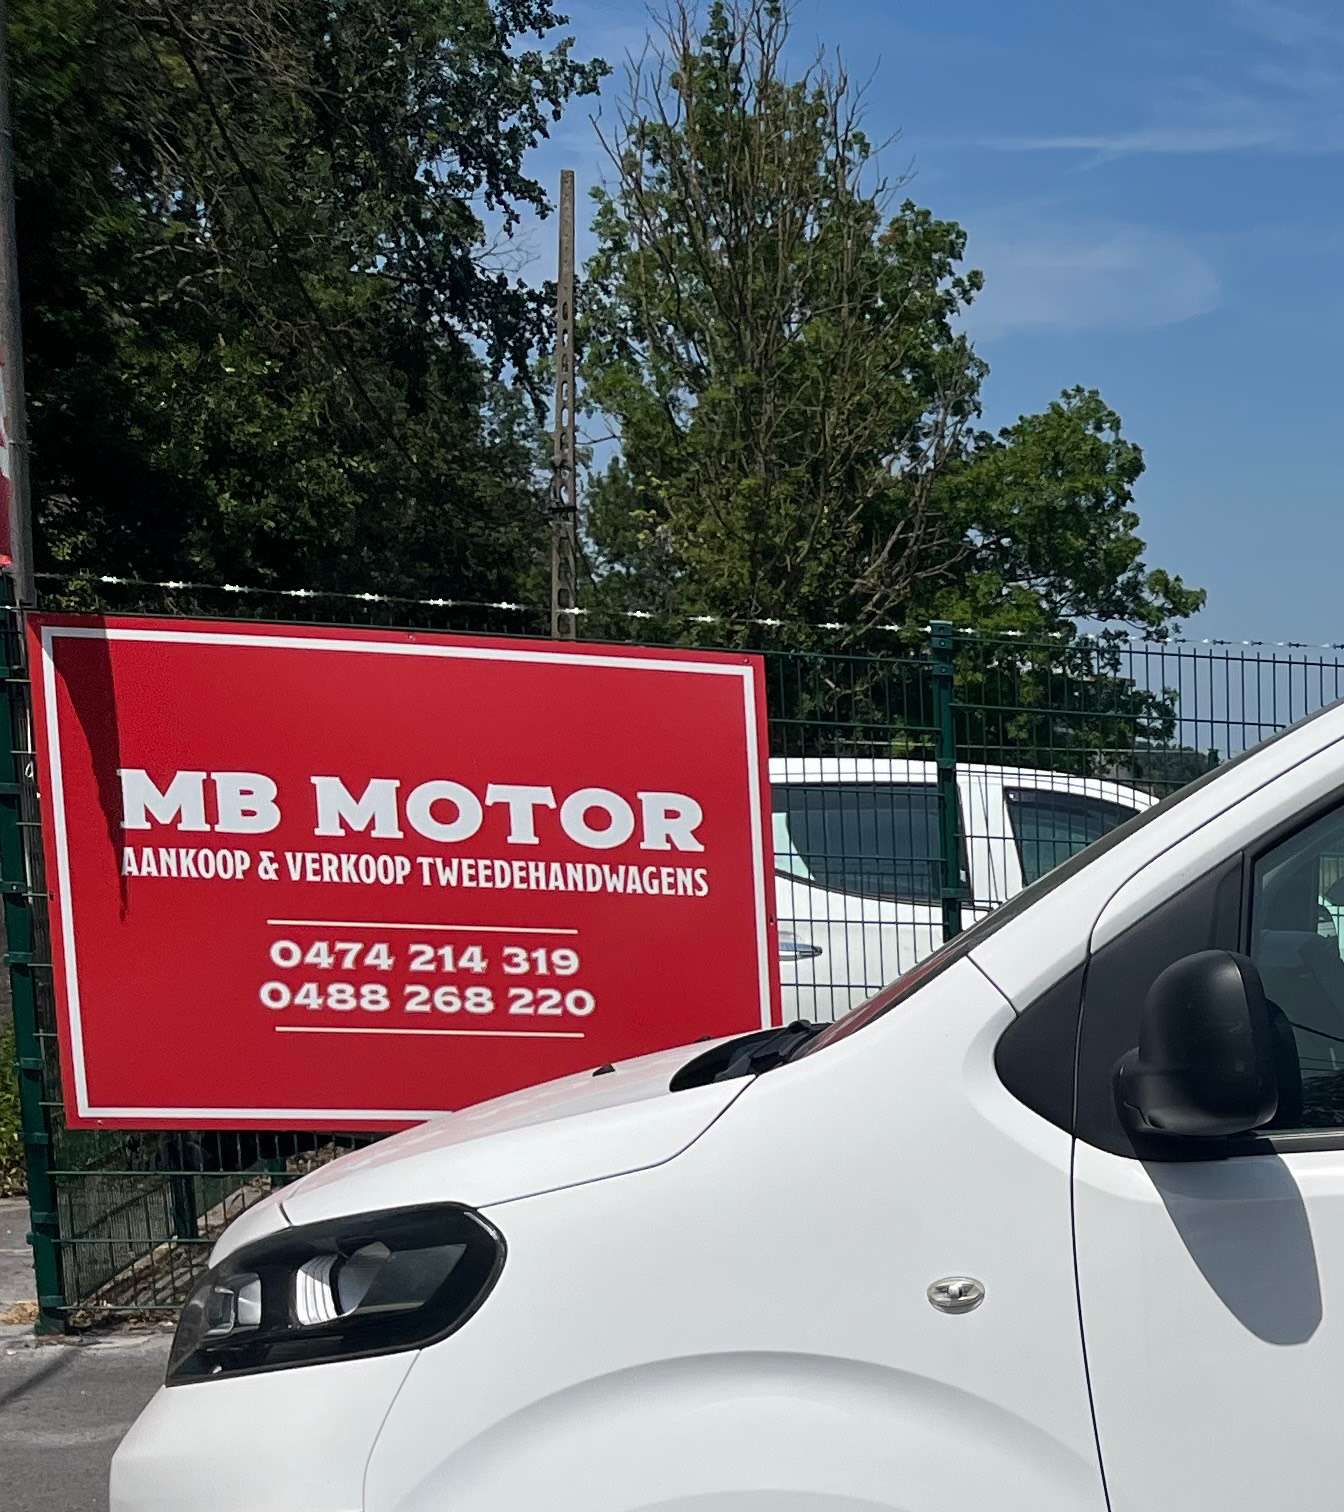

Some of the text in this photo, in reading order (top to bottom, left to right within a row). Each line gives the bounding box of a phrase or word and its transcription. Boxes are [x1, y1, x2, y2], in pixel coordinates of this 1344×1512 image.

[117, 769, 705, 852] MB MOTOR
[122, 846, 709, 897] AANKOOP & VERKOOP TWEEDEHANDWAGENS
[270, 940, 580, 976] 0474 214 319
[259, 981, 595, 1016] 0488 268 220
